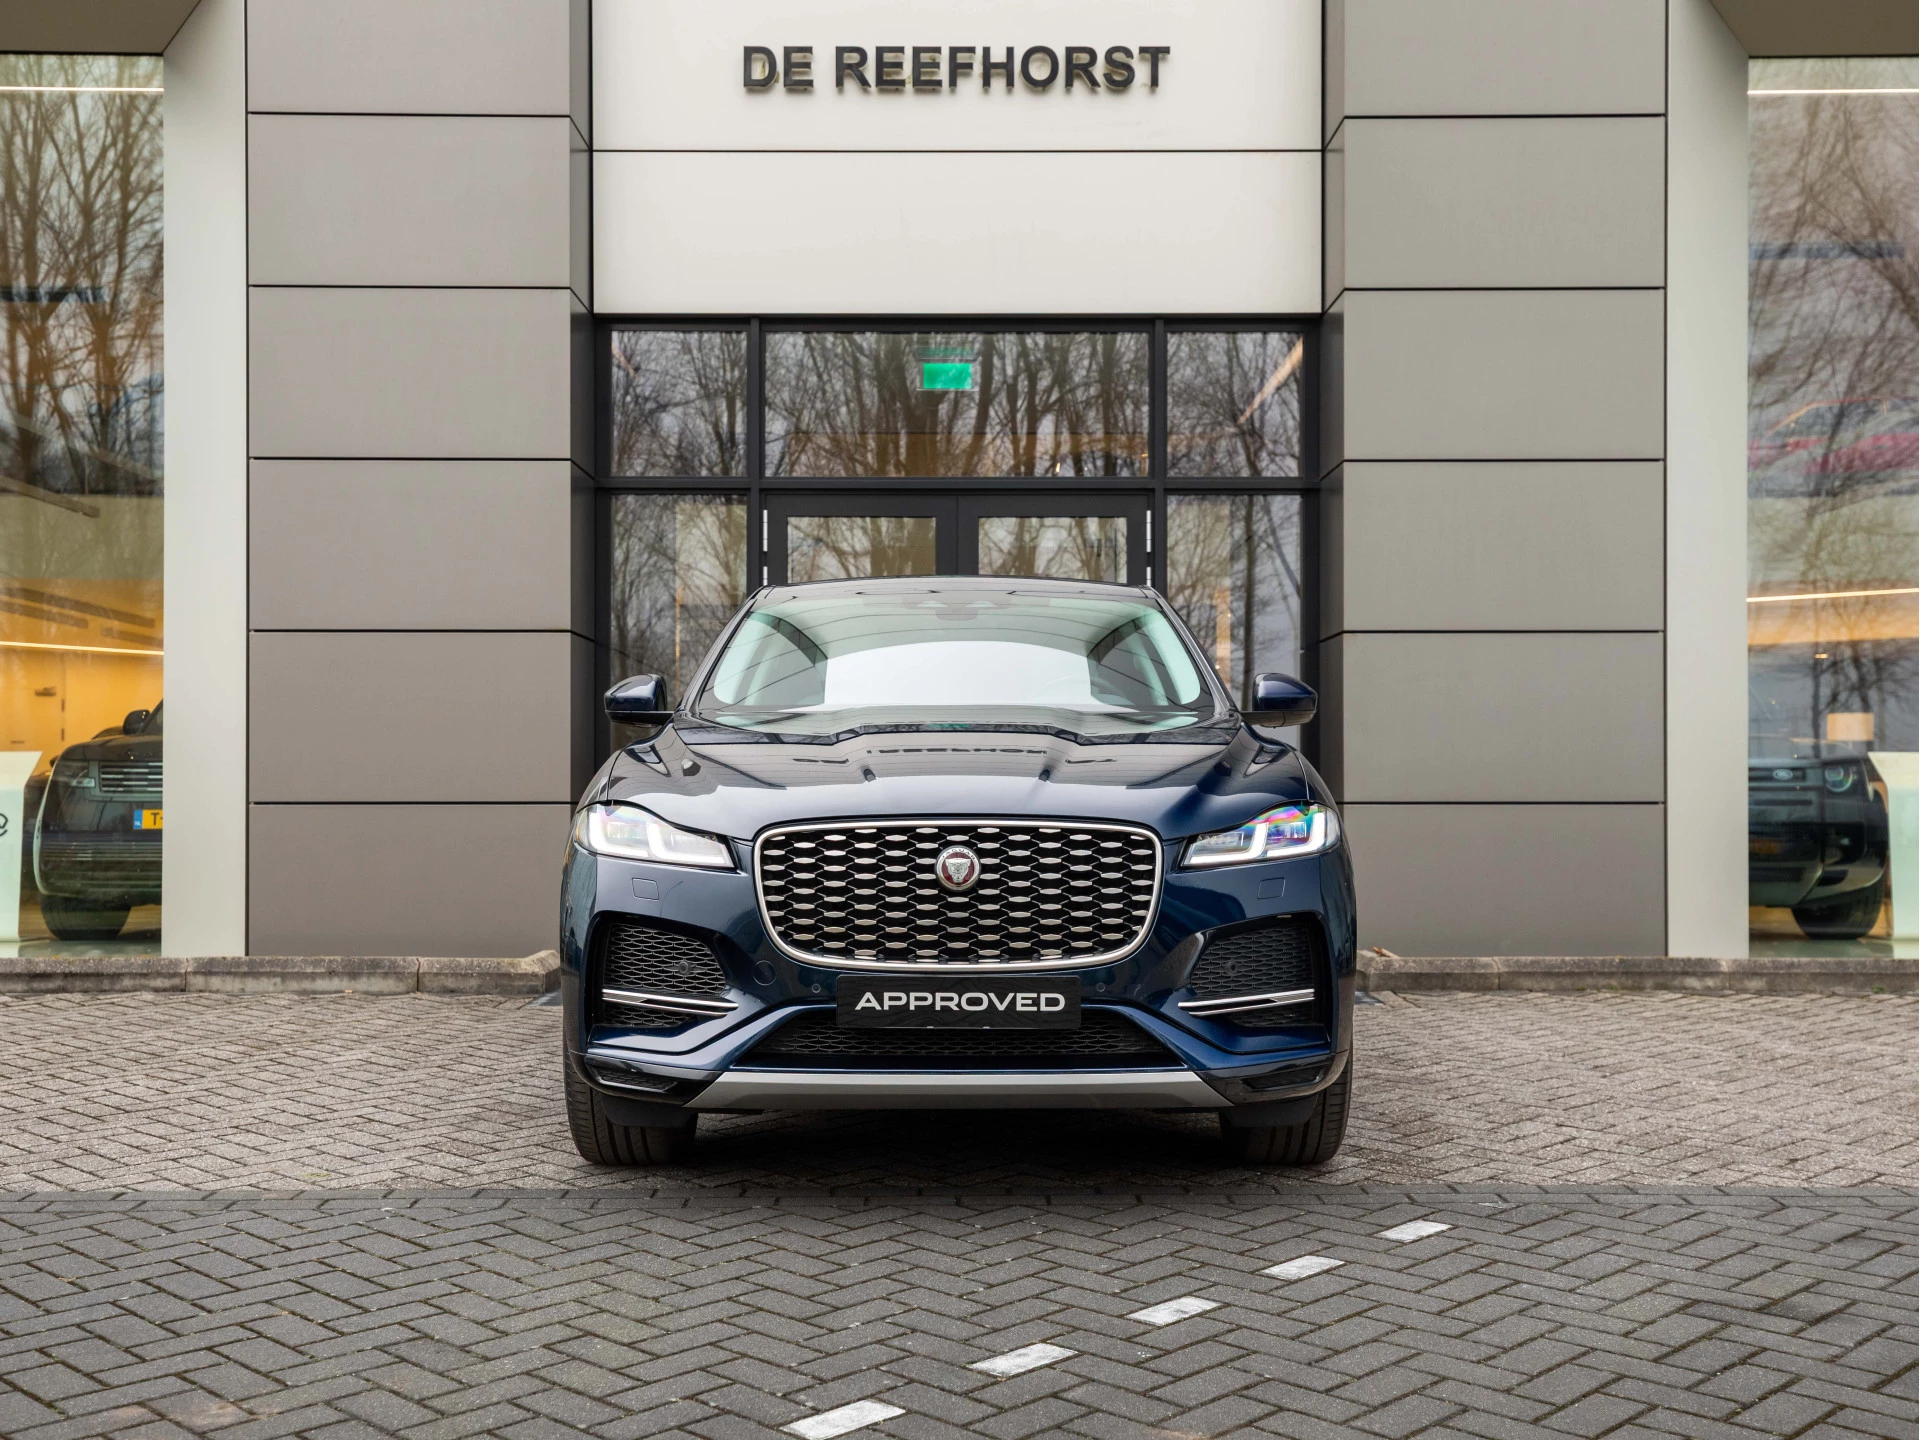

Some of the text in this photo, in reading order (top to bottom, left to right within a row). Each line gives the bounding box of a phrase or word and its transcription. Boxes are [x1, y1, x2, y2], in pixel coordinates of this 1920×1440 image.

[743, 45, 1171, 90] DE REEFHORST
[855, 991, 1066, 1012] APPROVED
